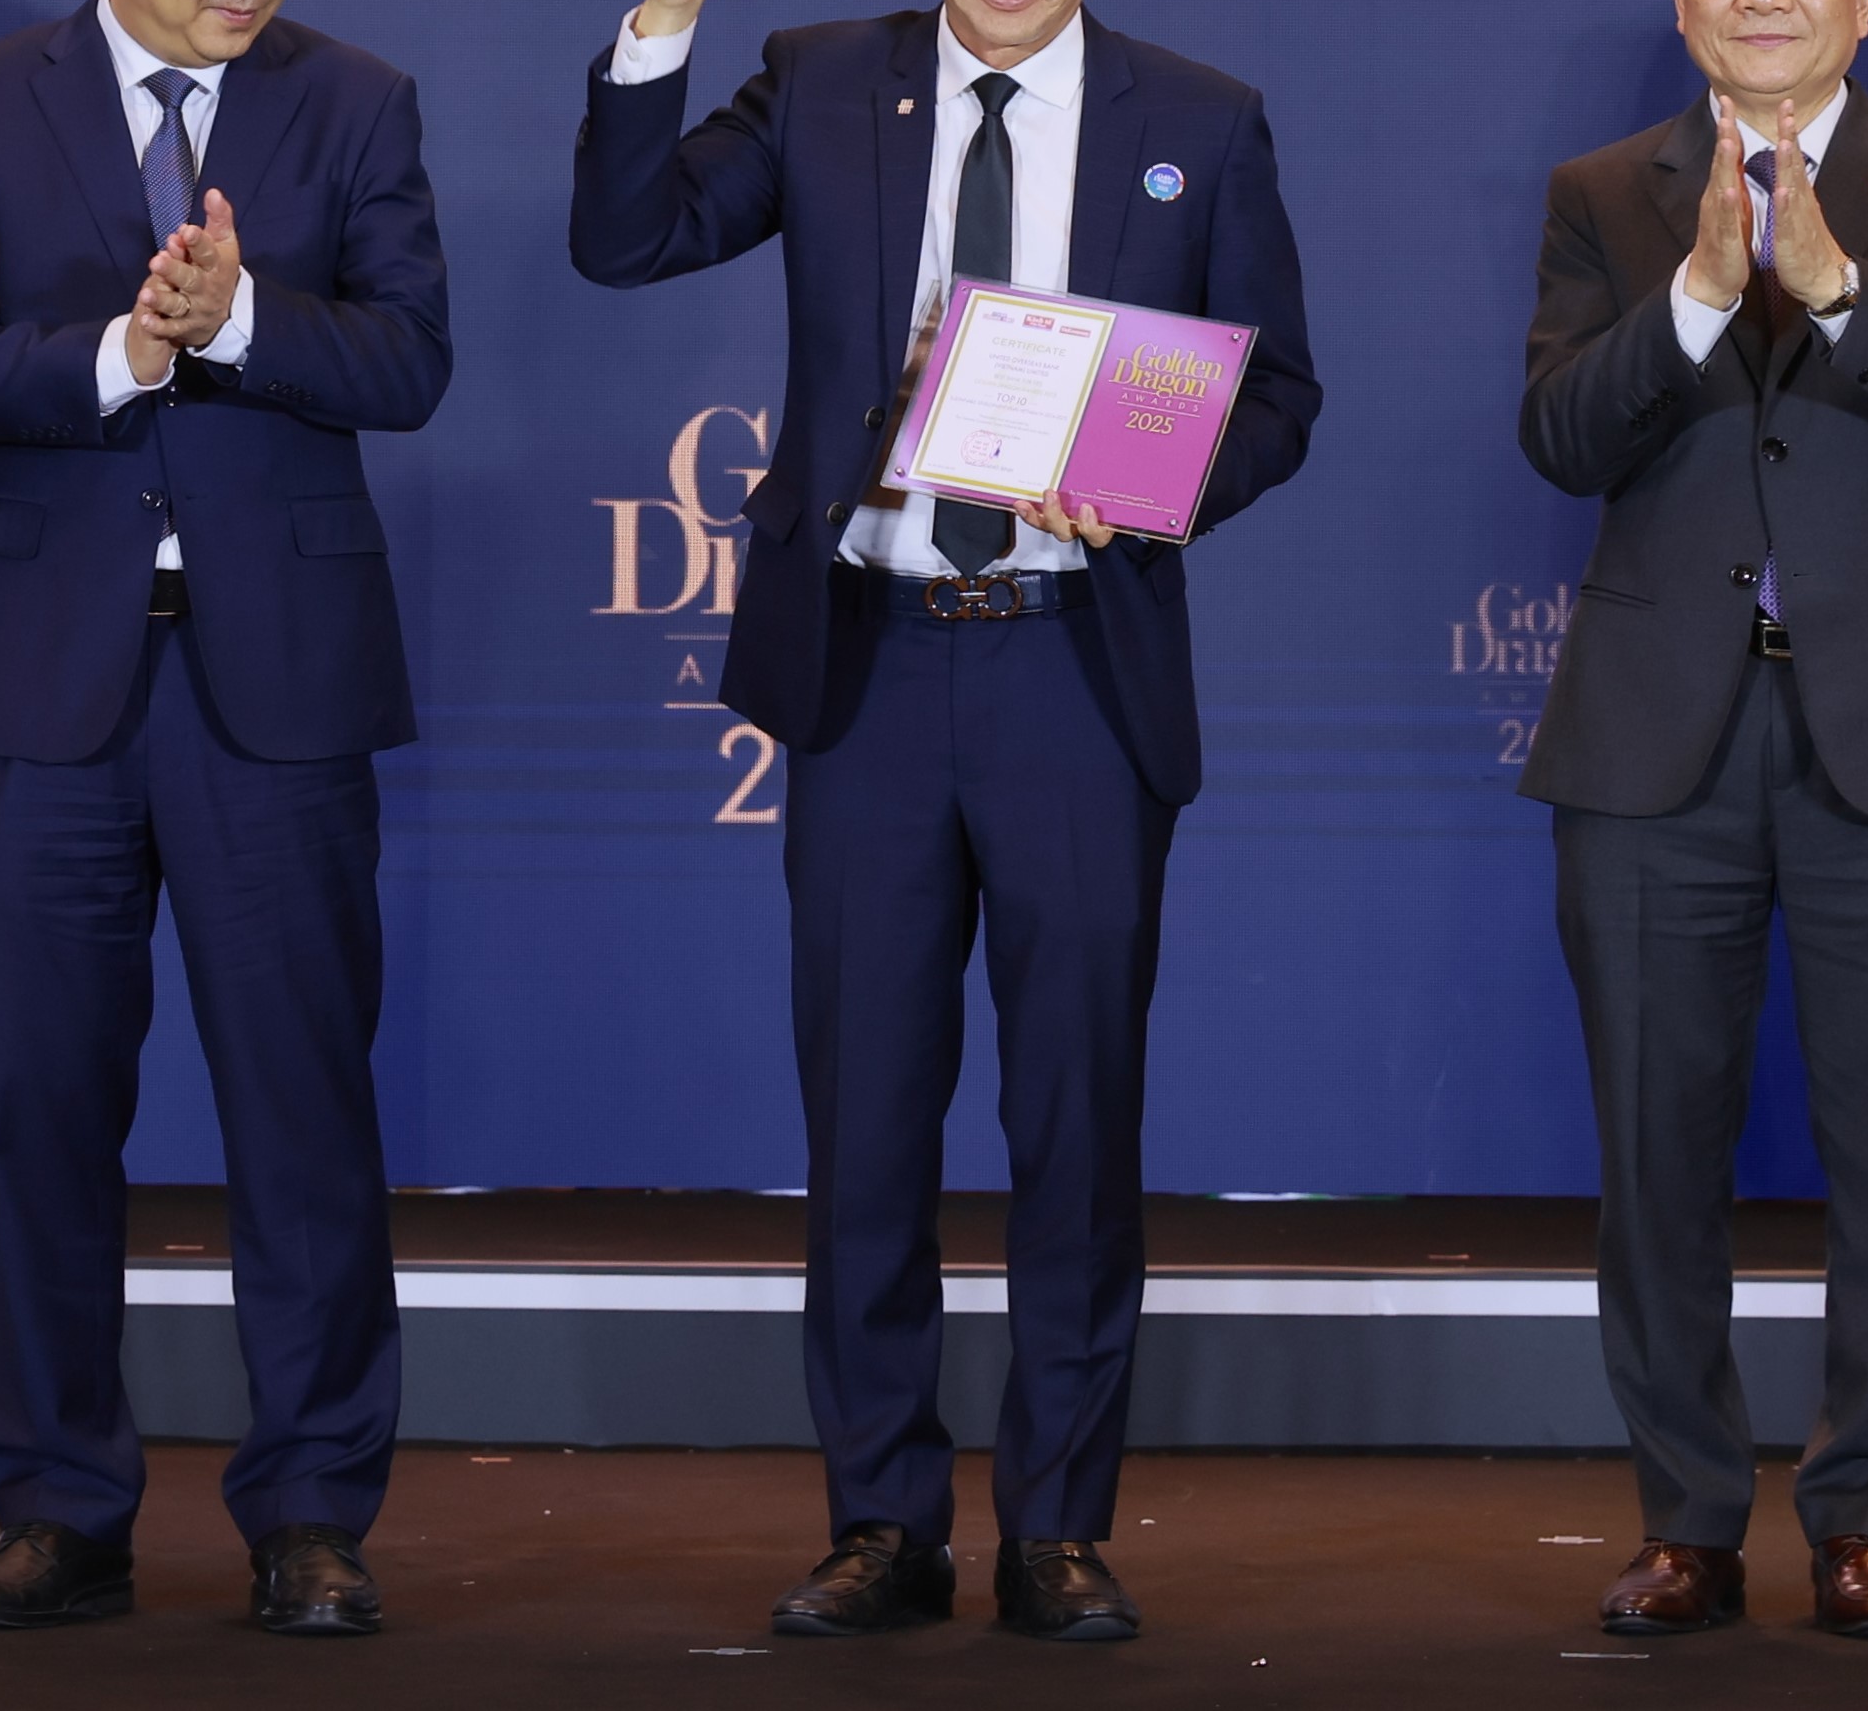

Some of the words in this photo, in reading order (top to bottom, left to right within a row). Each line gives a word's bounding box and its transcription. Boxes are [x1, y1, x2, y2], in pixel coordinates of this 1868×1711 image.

[991, 336, 1067, 357] CERTIFICATE
[1131, 341, 1224, 381] Golden
[1108, 357, 1208, 399] Dragon
[1121, 392, 1199, 413] AWARDS
[1125, 410, 1176, 435] 2025
[1475, 581, 1575, 635] Gol
